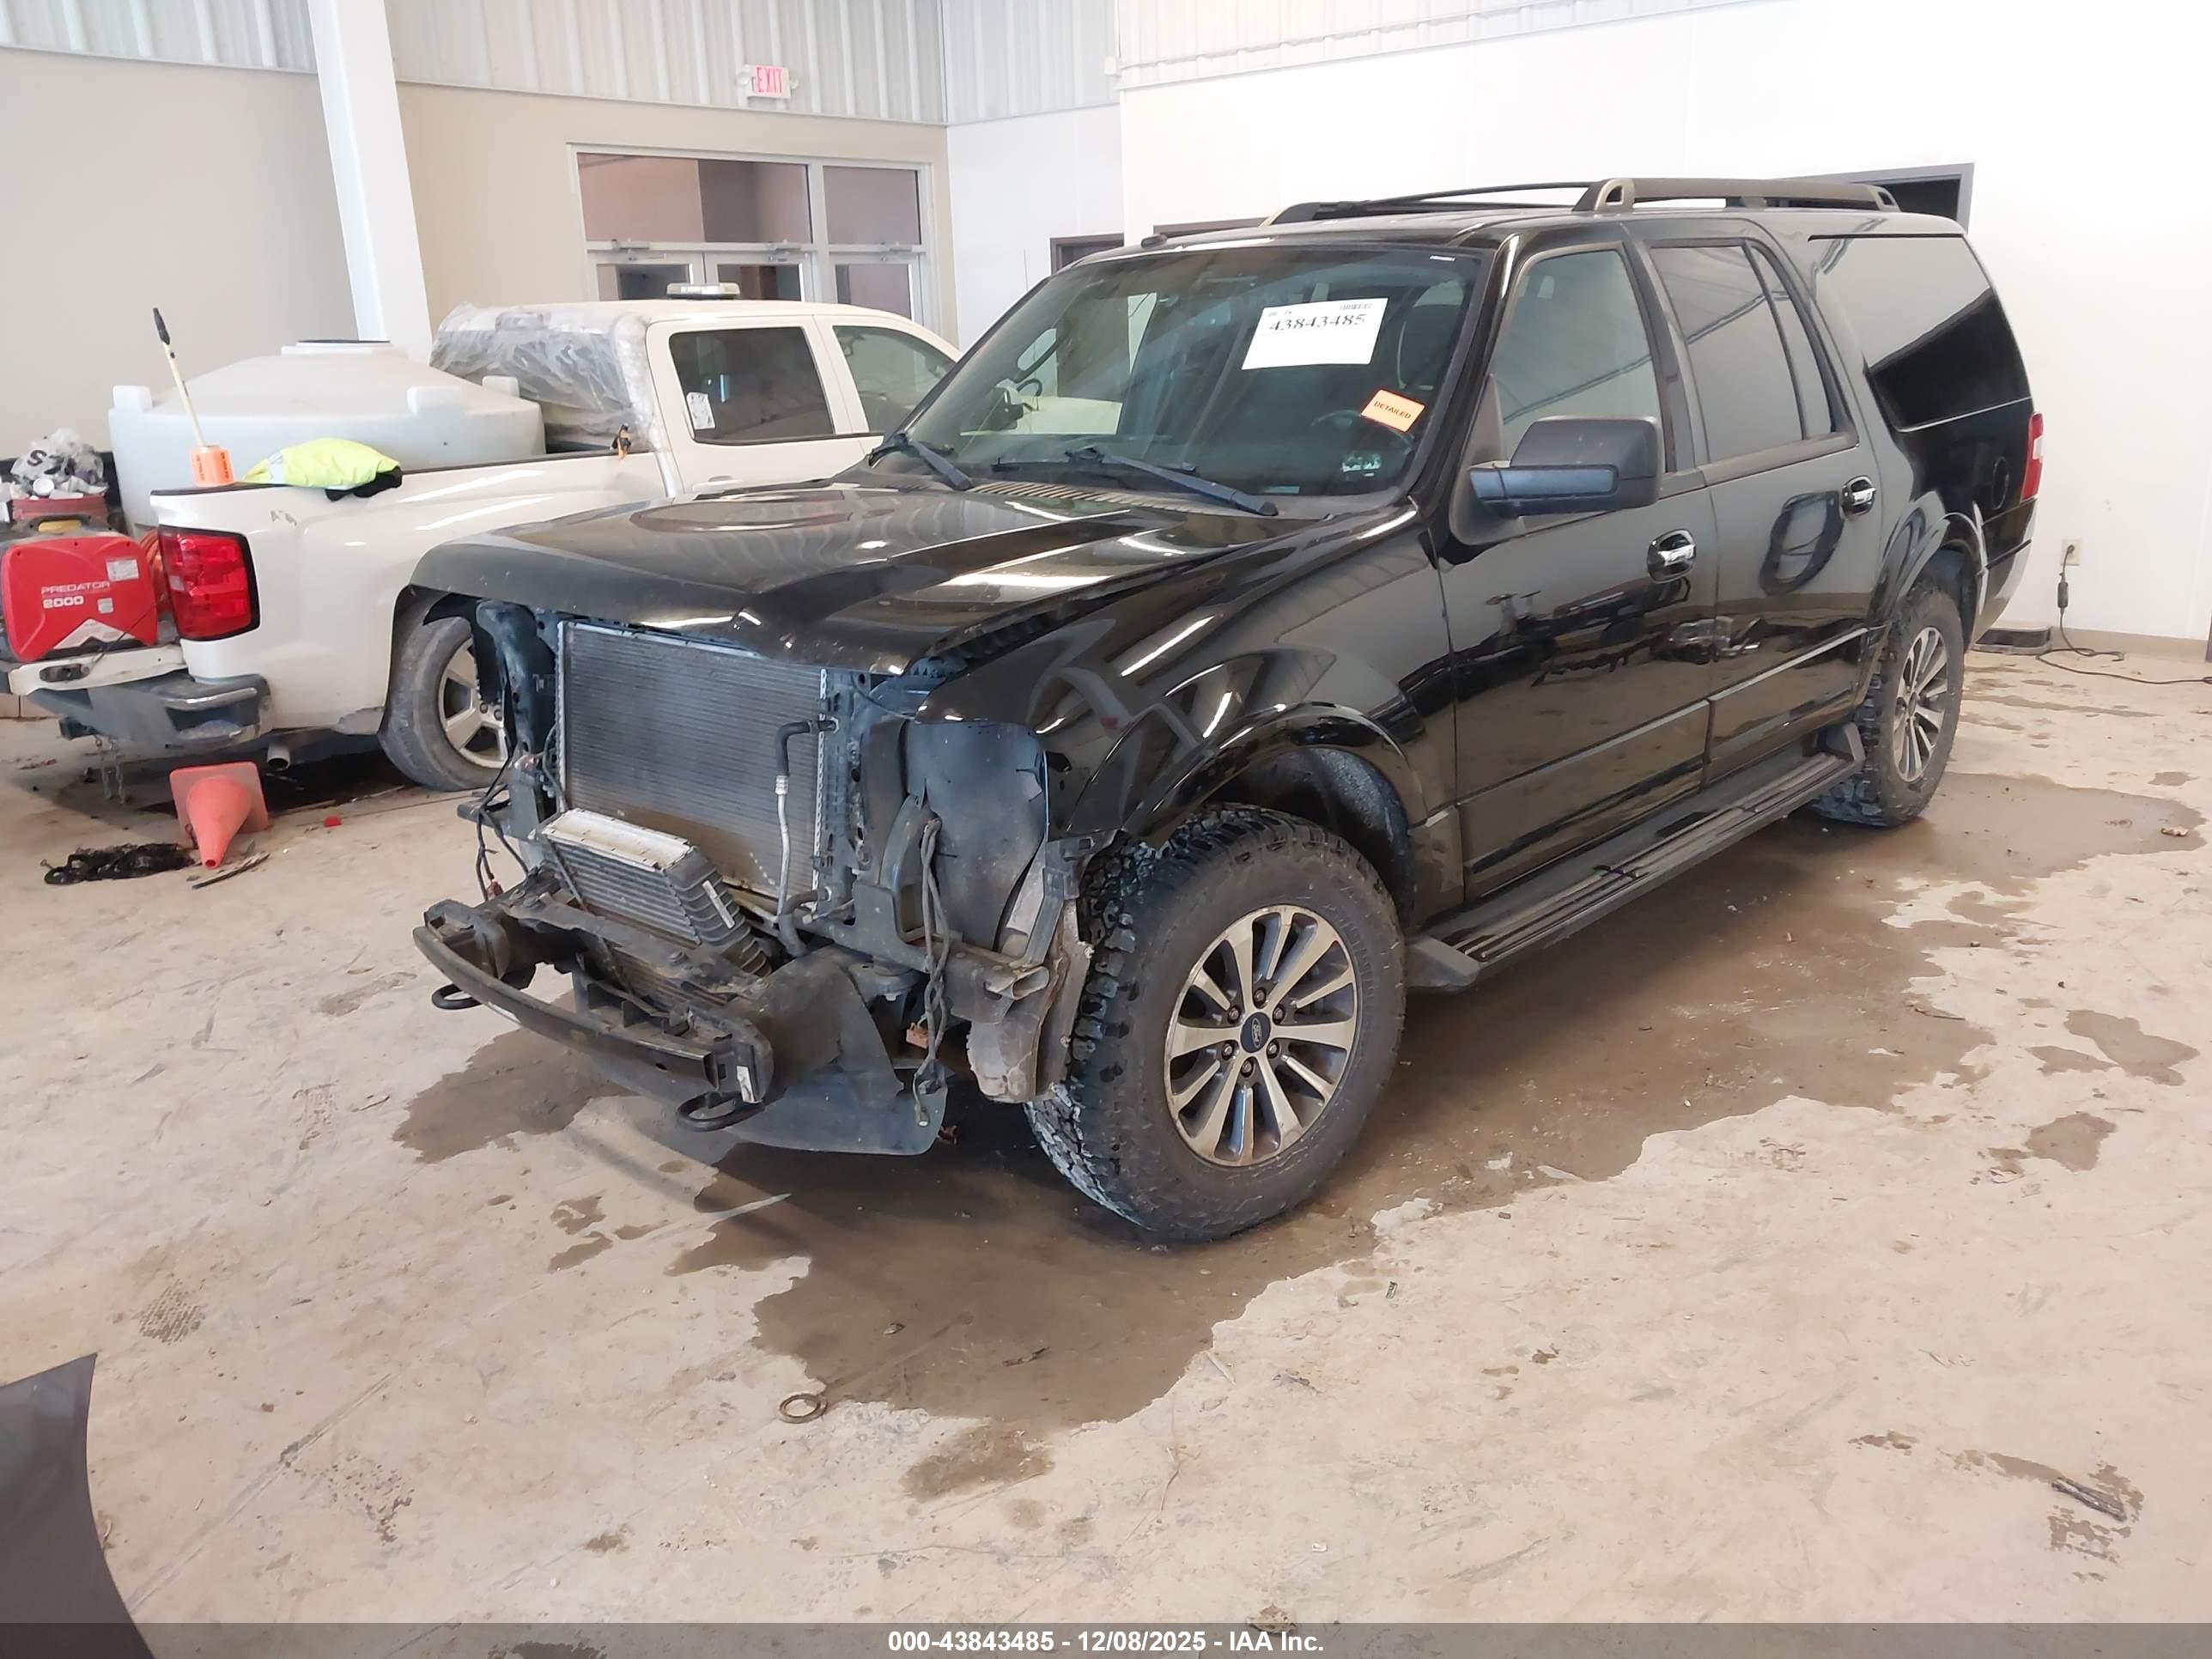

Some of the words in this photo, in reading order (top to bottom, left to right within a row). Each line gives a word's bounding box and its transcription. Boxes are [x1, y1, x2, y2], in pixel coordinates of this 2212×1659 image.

[757, 67, 783, 93] EXIT
[1269, 313, 1367, 331] 43843485
[1374, 401, 1412, 419] DETAILED
[41, 580, 111, 594] PREDATOR
[43, 595, 84, 609] 2000
